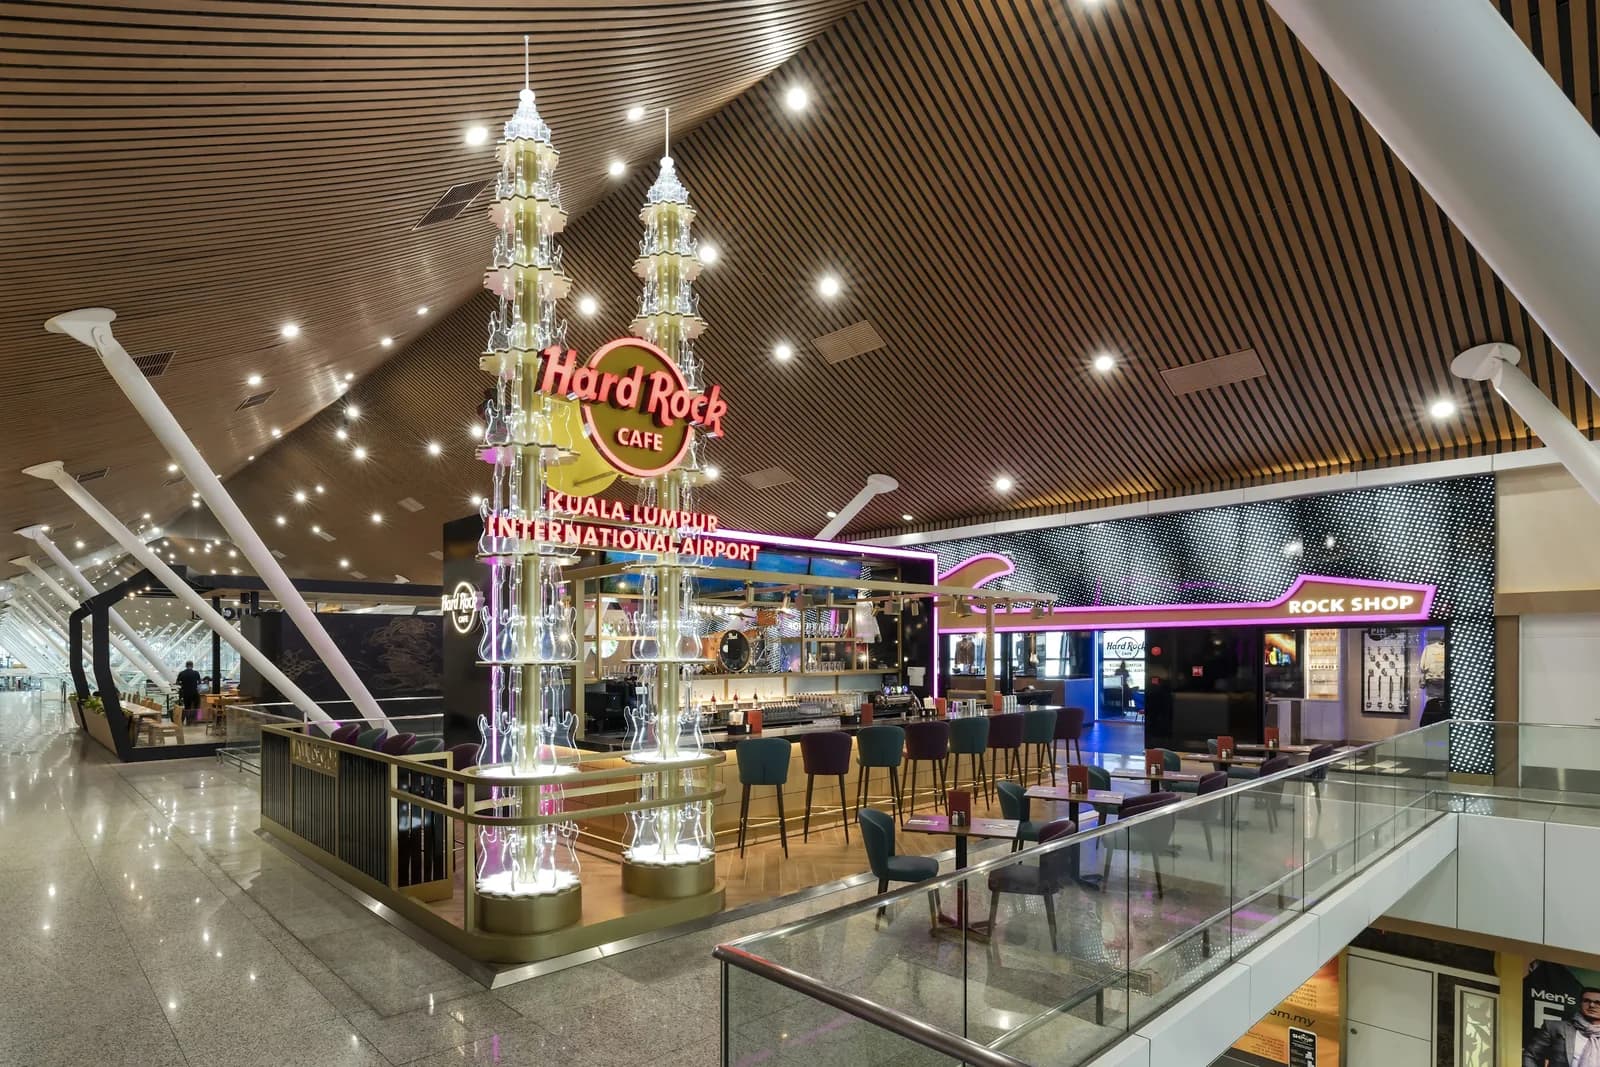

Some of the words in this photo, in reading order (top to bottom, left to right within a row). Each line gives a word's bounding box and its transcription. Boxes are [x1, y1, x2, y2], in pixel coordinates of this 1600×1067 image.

[541, 345, 644, 409] Hard
[645, 371, 727, 438] Rock
[617, 427, 663, 451] CAFE
[547, 491, 626, 520] KUALA
[632, 504, 720, 532] LUMPUR
[486, 515, 681, 556] INTERNATIONAL
[680, 537, 760, 562] AIRPORT
[441, 593, 459, 611] Hard
[459, 591, 477, 613] Rock
[1288, 599, 1345, 614] ROCK
[1350, 595, 1414, 611] SHOP
[1106, 641, 1126, 650] Hard
[1530, 988, 1577, 1005] Men's
